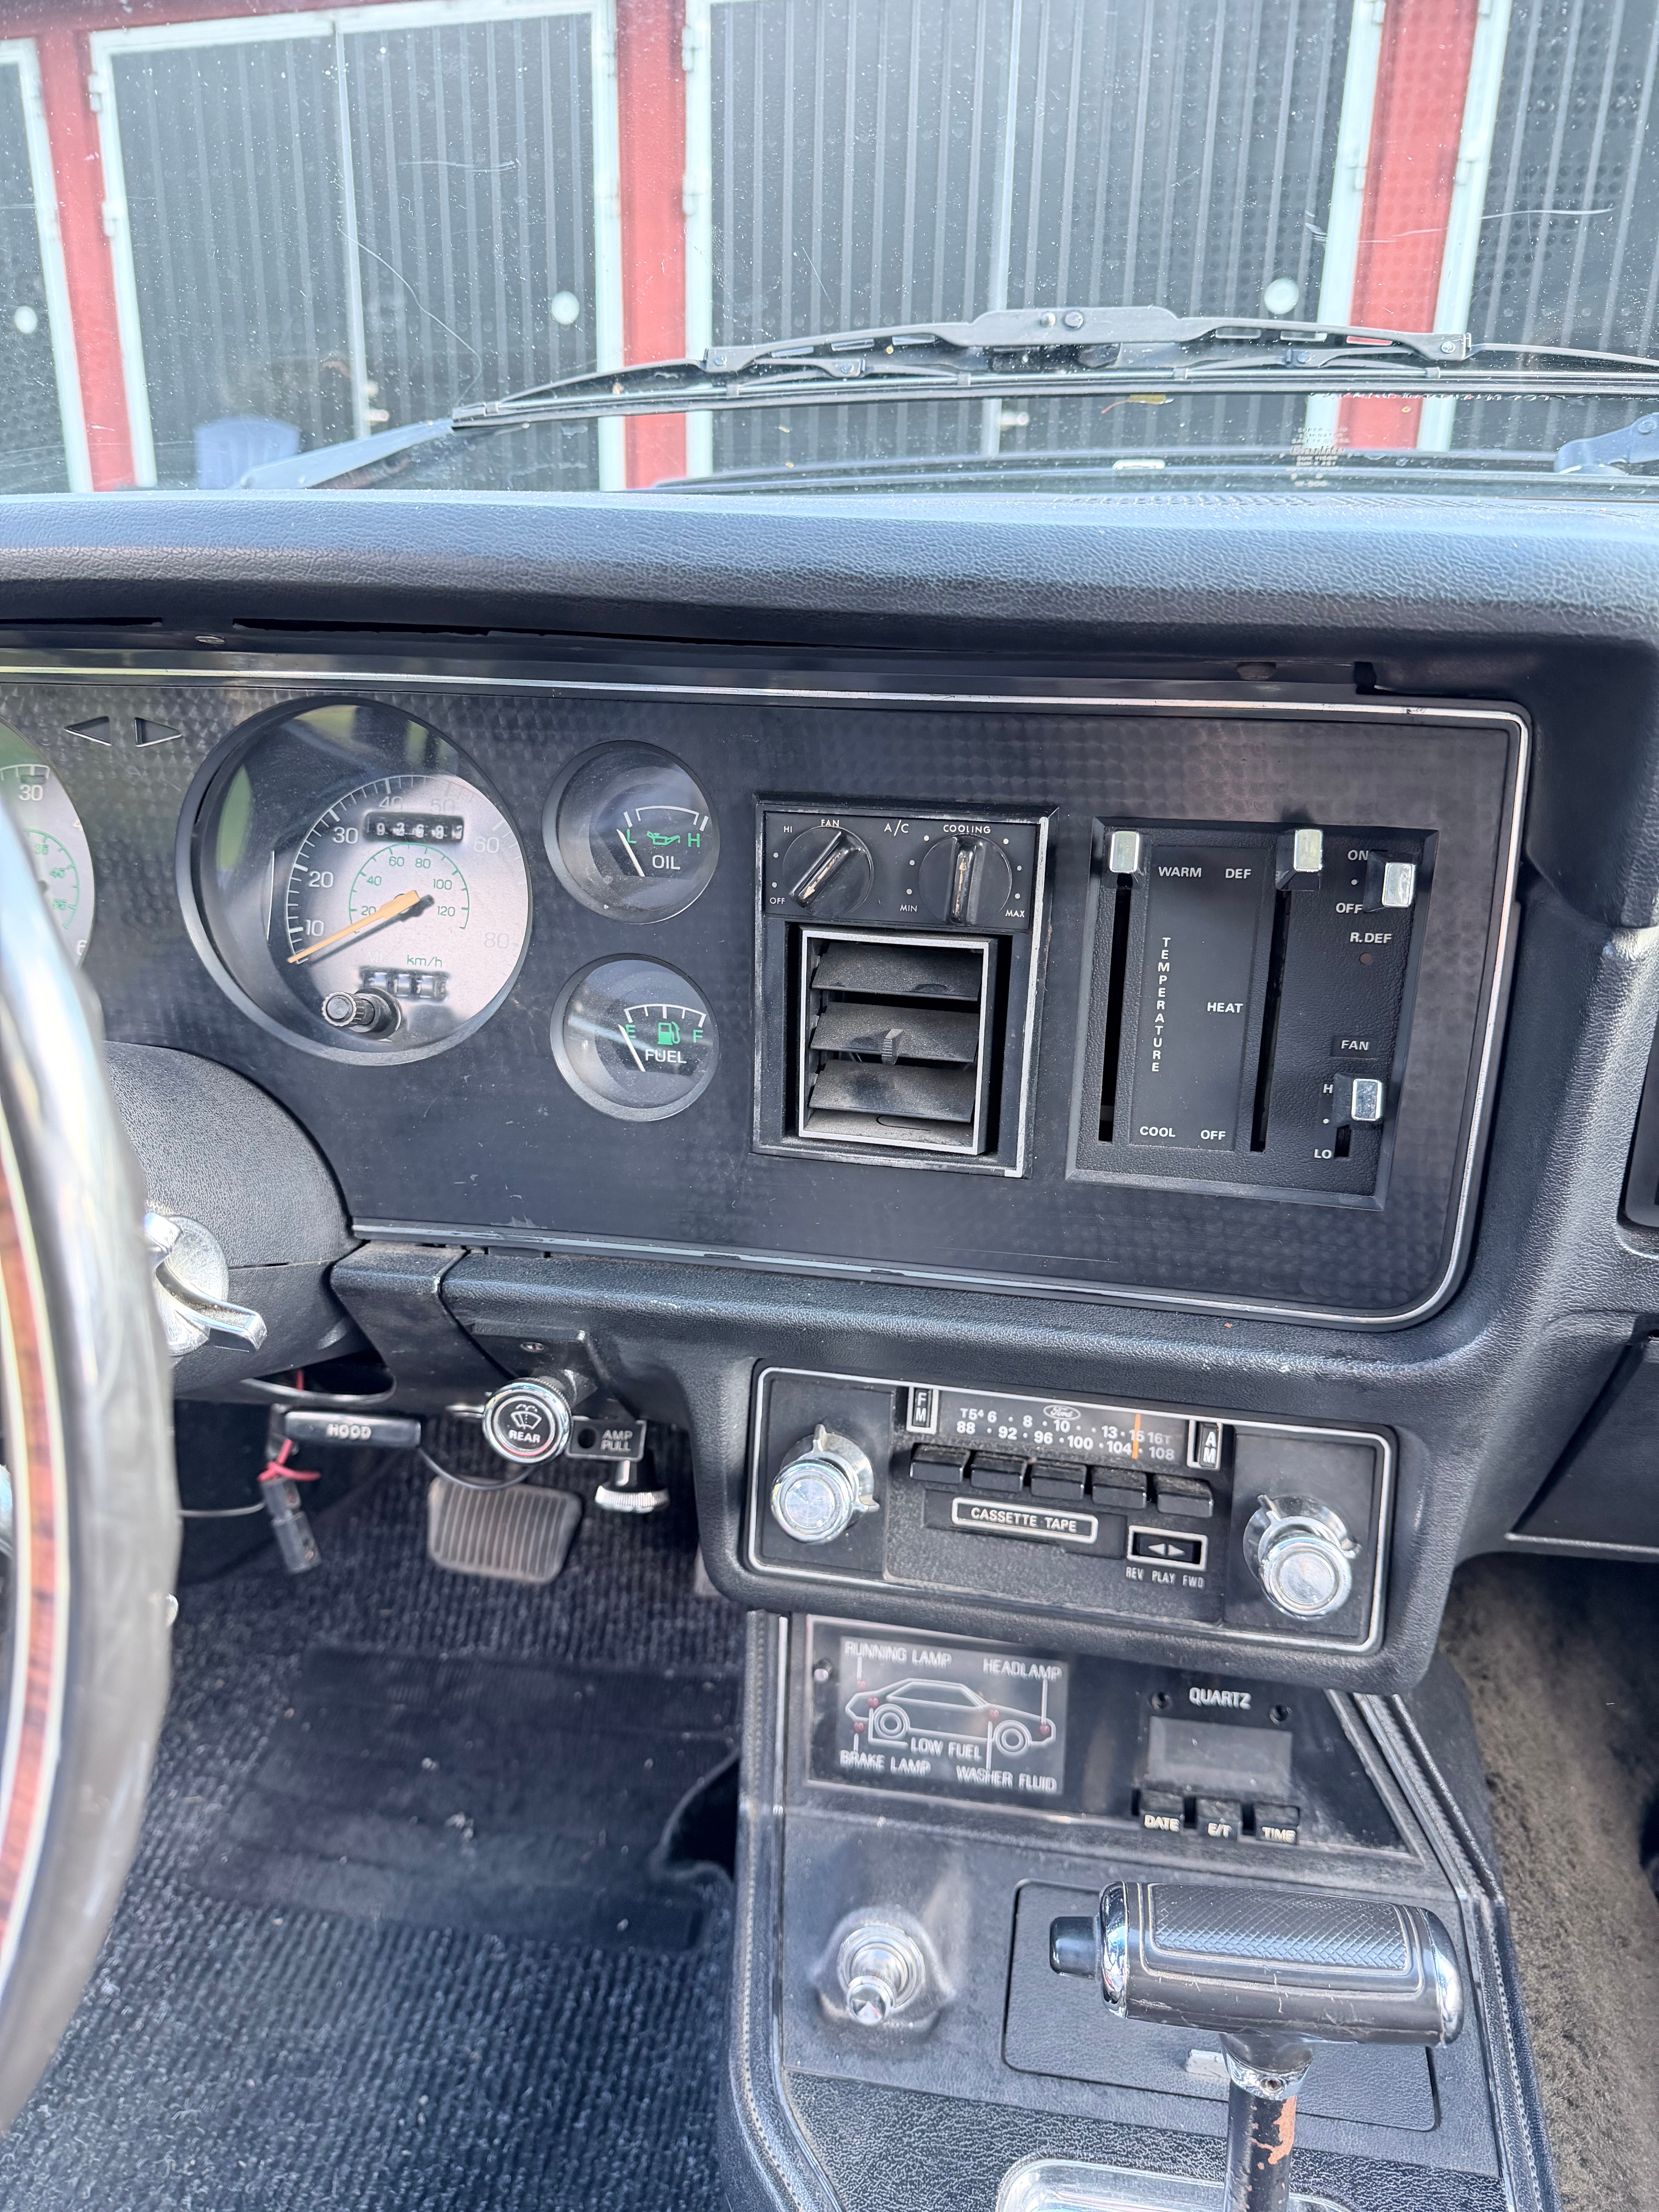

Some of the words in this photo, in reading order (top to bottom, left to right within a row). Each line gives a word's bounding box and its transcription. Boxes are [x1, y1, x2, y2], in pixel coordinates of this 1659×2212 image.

[19, 784, 43, 801] 30
[379, 796, 403, 812] 40
[431, 799, 455, 815] 50
[783, 825, 793, 833] HI
[821, 819, 840, 828] FAN
[884, 820, 909, 836] A/C
[943, 824, 991, 834] COOLING
[333, 827, 359, 844] 30
[627, 829, 636, 844] L
[688, 833, 700, 847] H
[474, 836, 499, 853] 60
[389, 857, 404, 867] 60
[652, 855, 681, 870] OIL
[1347, 849, 1369, 861] ON
[415, 859, 431, 868] 80
[309, 871, 333, 888] 20
[1158, 866, 1202, 878] WARM
[1225, 868, 1252, 879] DEF
[366, 876, 382, 886] 40
[433, 879, 452, 890] 100
[769, 897, 786, 905] OFF
[900, 904, 917, 913] MIN
[1336, 902, 1364, 914] OFF
[361, 906, 376, 916] 20
[437, 906, 455, 917] 120
[1005, 910, 1025, 918] MAX
[306, 919, 324, 936] 10
[484, 932, 510, 949] 80
[407, 955, 442, 967] km/h
[1151, 937, 1171, 1072] TEMPERATURE
[1207, 1002, 1243, 1013] HEAT
[625, 1024, 636, 1039] E
[693, 1030, 703, 1043] F
[1341, 1040, 1369, 1051] FAN
[645, 1049, 687, 1064] FUEL
[1139, 1126, 1176, 1139] COOL
[1200, 1129, 1226, 1140] OFF
[1314, 1149, 1332, 1159] LO
[915, 1392, 928, 1423] FM
[1050, 1406, 1074, 1418] Ford
[326, 1423, 372, 1441] HOOD
[988, 1410, 997, 1423] 6
[1023, 1415, 1033, 1428] 8
[1053, 1419, 1071, 1433] 10
[1101, 1425, 1118, 1439] 13
[508, 1429, 541, 1443] REAR
[602, 1429, 633, 1440] AMP
[956, 1420, 976, 1435] 88
[998, 1425, 1017, 1441] 92
[1034, 1431, 1053, 1445] 96
[1067, 1435, 1094, 1451] 100
[1106, 1440, 1133, 1456] 104
[1149, 1446, 1175, 1461] 108
[600, 1440, 632, 1453] PULL
[1203, 1432, 1218, 1463] AM
[971, 1506, 1037, 1528] CASSETTE
[1044, 1516, 1078, 1534] TAPE
[1126, 1566, 1144, 1581] REV
[1152, 1570, 1175, 1585] PLAY
[1182, 1575, 1205, 1589] FWD
[844, 1640, 907, 1662] RUNNING
[911, 1648, 952, 1667] LAMP
[982, 1657, 1063, 1681] HEADLAMP
[1188, 1686, 1252, 1710] QUARTZ
[910, 1737, 943, 1757] LOW
[948, 1742, 982, 1762] FUEL
[839, 1749, 885, 1770] BRAKE
[890, 1756, 931, 1777] LAMP
[955, 1765, 1013, 1789] WASHER
[1018, 1773, 1057, 1793] FLUID
[1144, 1814, 1180, 1832] DATE
[1207, 1822, 1233, 1839] E/T
[1262, 1826, 1297, 1844] TIME
